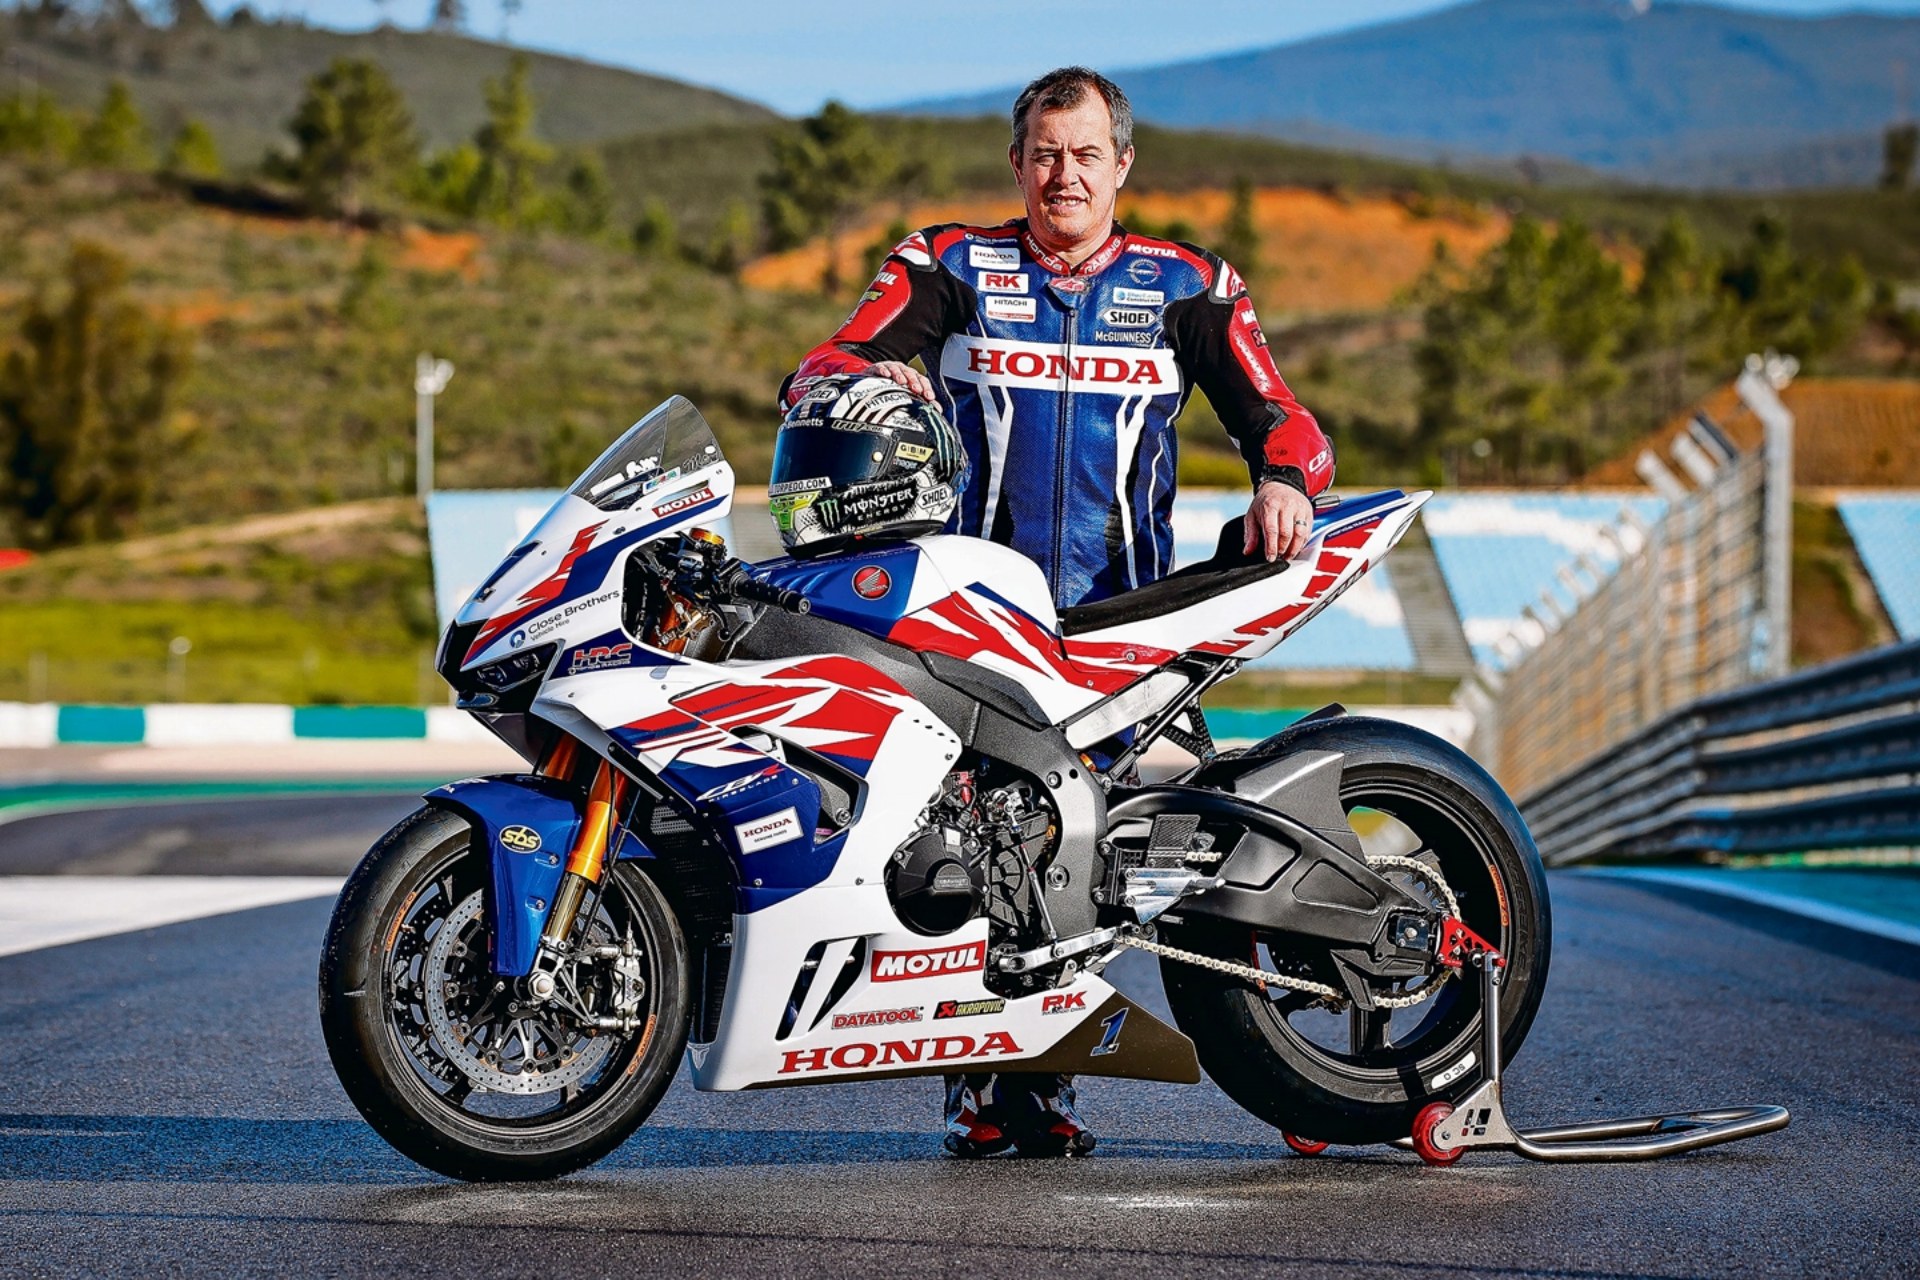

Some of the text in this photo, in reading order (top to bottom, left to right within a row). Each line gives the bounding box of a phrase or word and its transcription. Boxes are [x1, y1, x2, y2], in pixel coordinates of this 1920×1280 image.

[974, 250, 1015, 260] HONDA
[1127, 243, 1180, 258] MOTUL
[985, 273, 1021, 288] RK
[994, 299, 1028, 307] HITACHI
[1109, 311, 1150, 324] SHOEI
[1095, 330, 1152, 344] McGUINNESS
[967, 347, 1163, 385] HONDA
[658, 489, 711, 515] MOTUL
[844, 488, 915, 515] MONSTER
[921, 486, 948, 506] SHOEI
[528, 590, 620, 634] Close Brothers
[530, 625, 554, 641] Vehicle
[743, 818, 793, 838] HONDA
[875, 946, 980, 977] MOTUL
[1042, 990, 1088, 1012] RK
[832, 1008, 923, 1030] DATATOOL
[1090, 1006, 1130, 1057] 1
[777, 1031, 1024, 1074] HONDA
